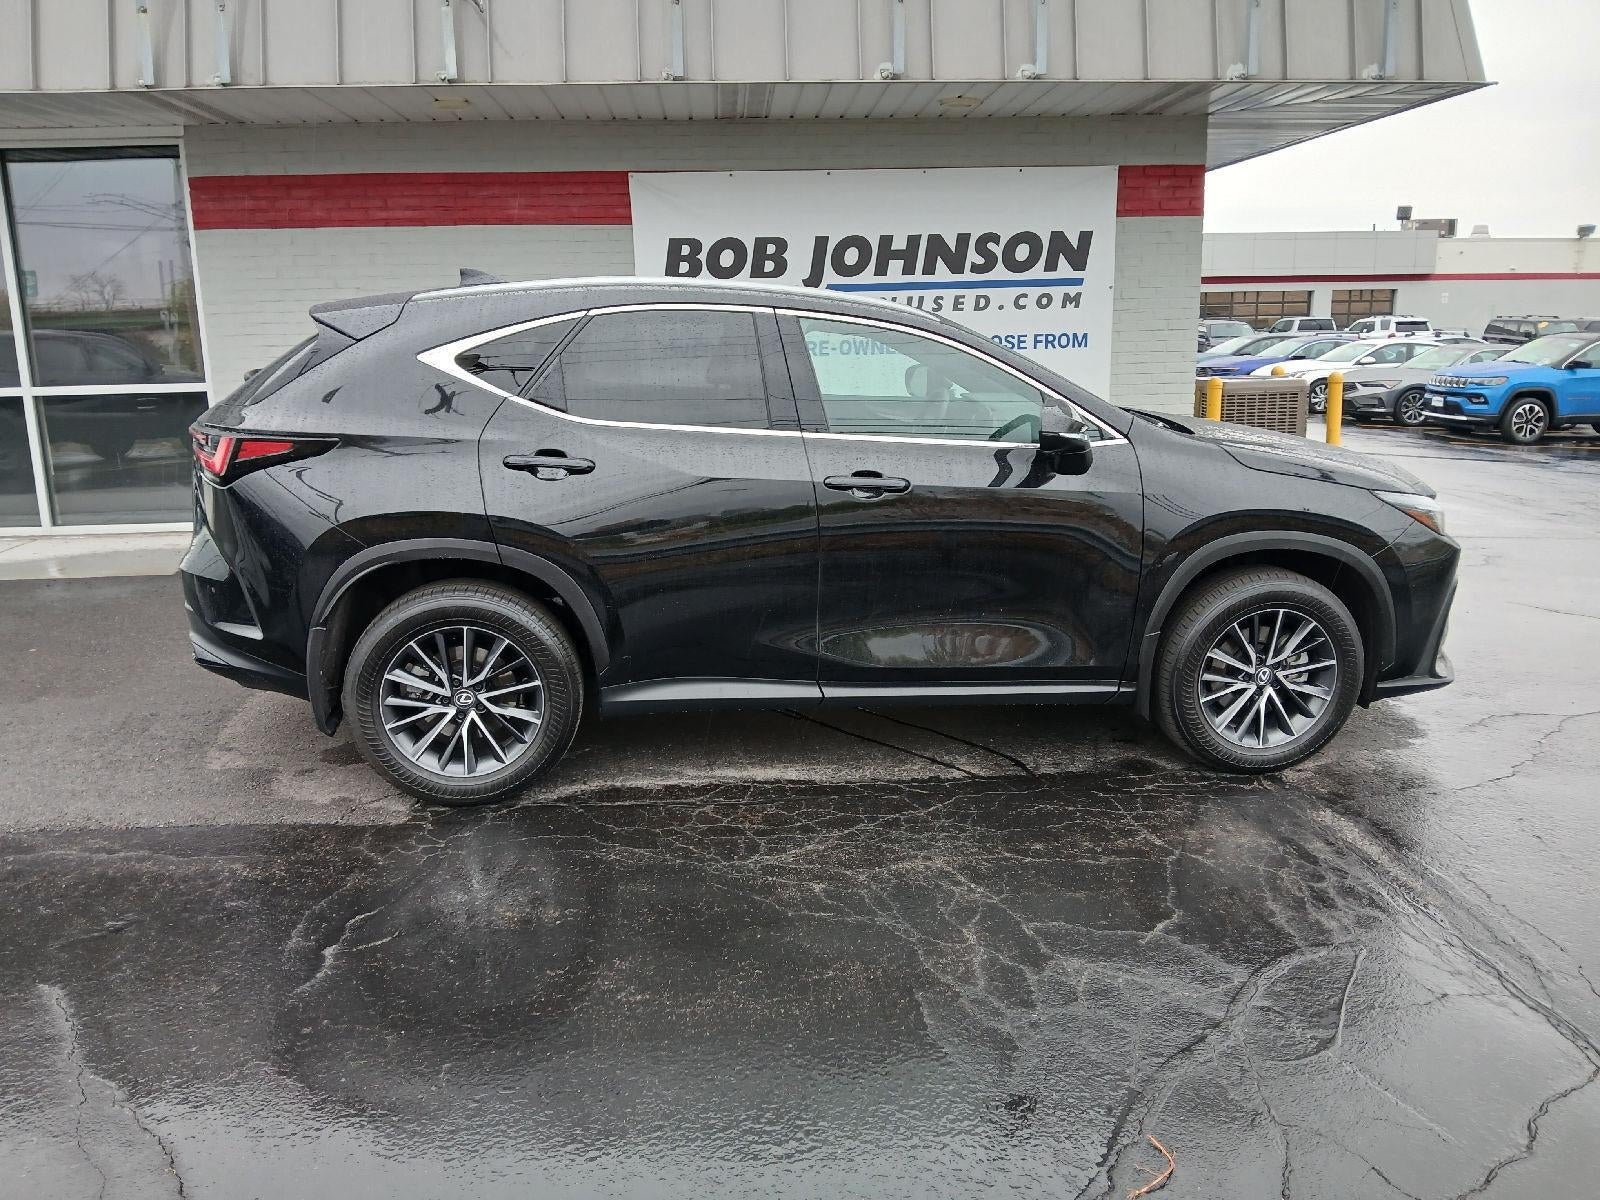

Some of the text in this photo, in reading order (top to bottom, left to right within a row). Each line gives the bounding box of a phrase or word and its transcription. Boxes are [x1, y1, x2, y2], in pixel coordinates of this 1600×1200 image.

[665, 230, 1093, 288] BOB JOHNSON
[880, 292, 1082, 313] USED.COM
[1033, 332, 1088, 350] FROM
